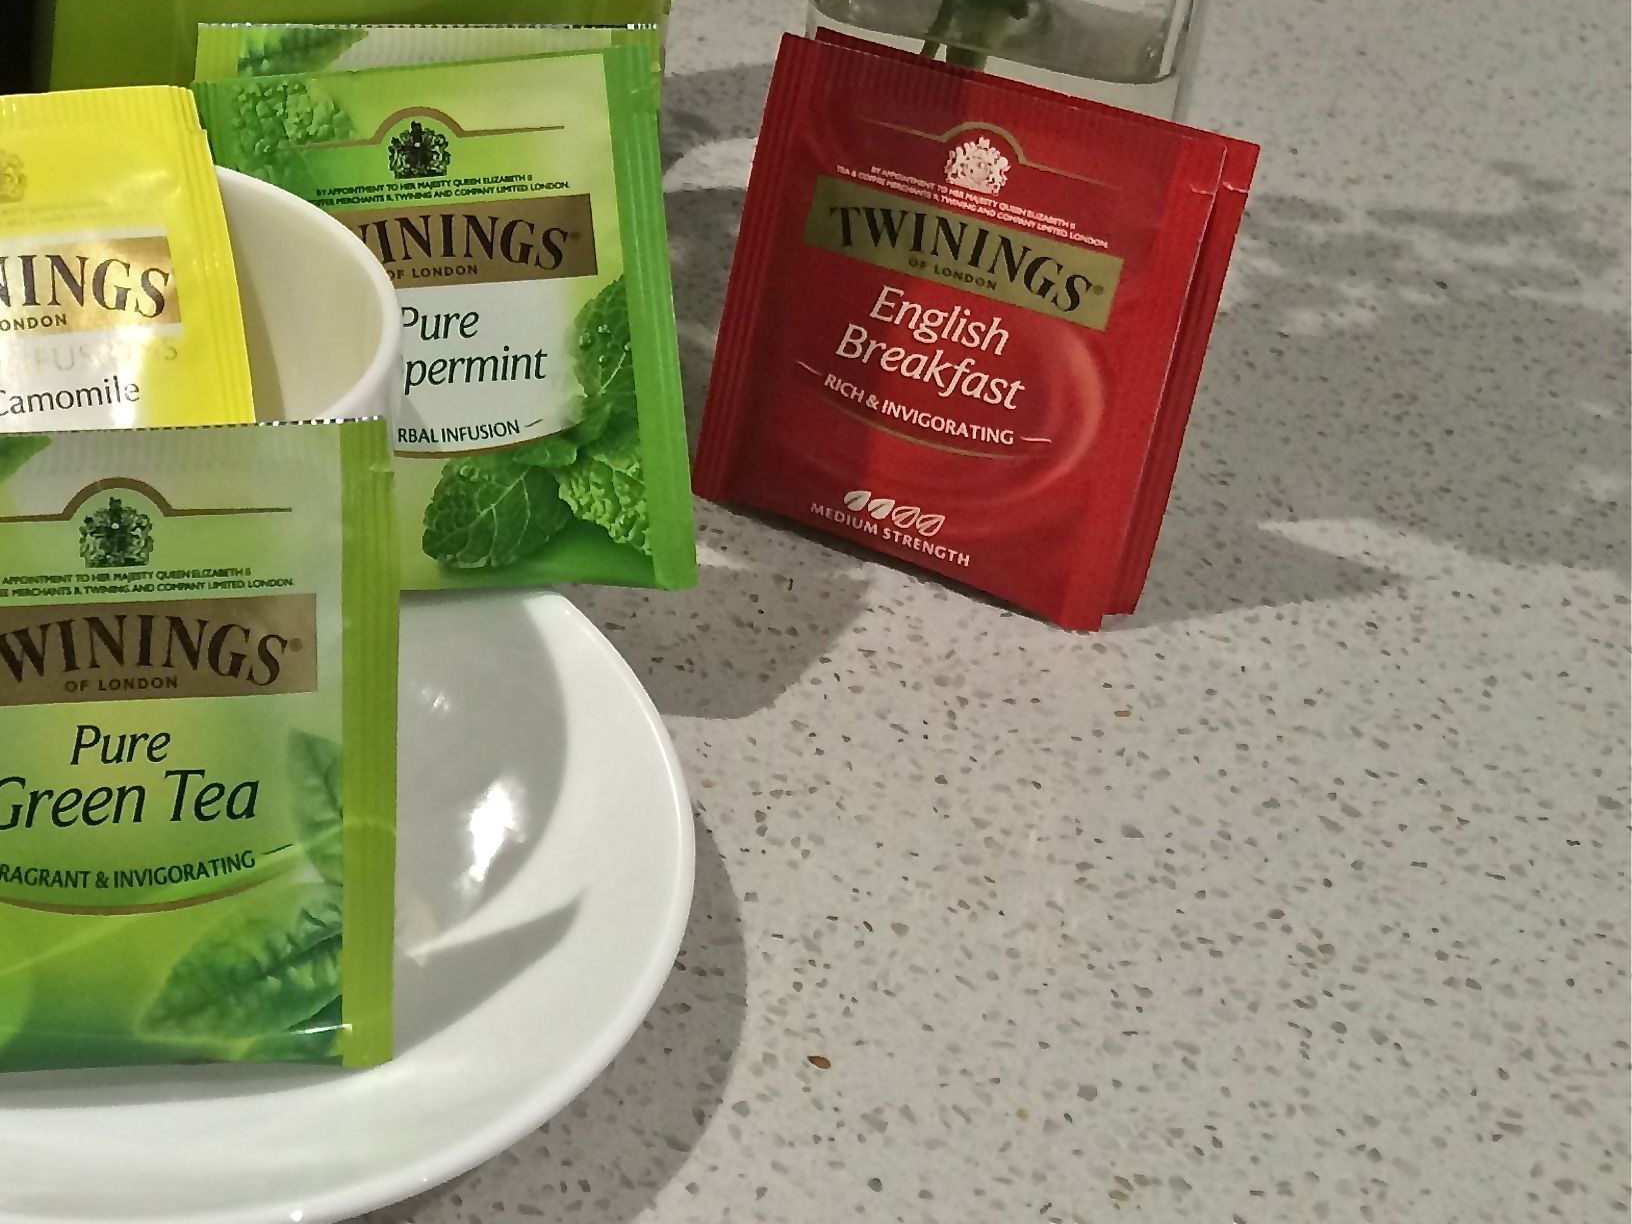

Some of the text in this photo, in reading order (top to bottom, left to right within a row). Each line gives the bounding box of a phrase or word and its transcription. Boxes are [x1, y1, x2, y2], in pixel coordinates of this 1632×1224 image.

[355, 213, 568, 271] ININGS
[829, 207, 1093, 313] TWININGS
[411, 263, 478, 279] LONDON
[907, 256, 998, 291] OF LONDON
[401, 306, 480, 341] Pure
[868, 284, 1009, 356] English
[401, 345, 548, 395] permint
[835, 323, 1026, 410] Breakfast
[441, 419, 520, 444] INFUSION
[823, 373, 1014, 445] RICH & INVIGORATING
[810, 503, 970, 567] MEDIUM STRENGTH
[64, 675, 179, 693] OF LONDON
[70, 725, 171, 766] Pure
[164, 769, 260, 822] Tea
[95, 871, 110, 889] &
[114, 850, 256, 889] INVIGORATING
